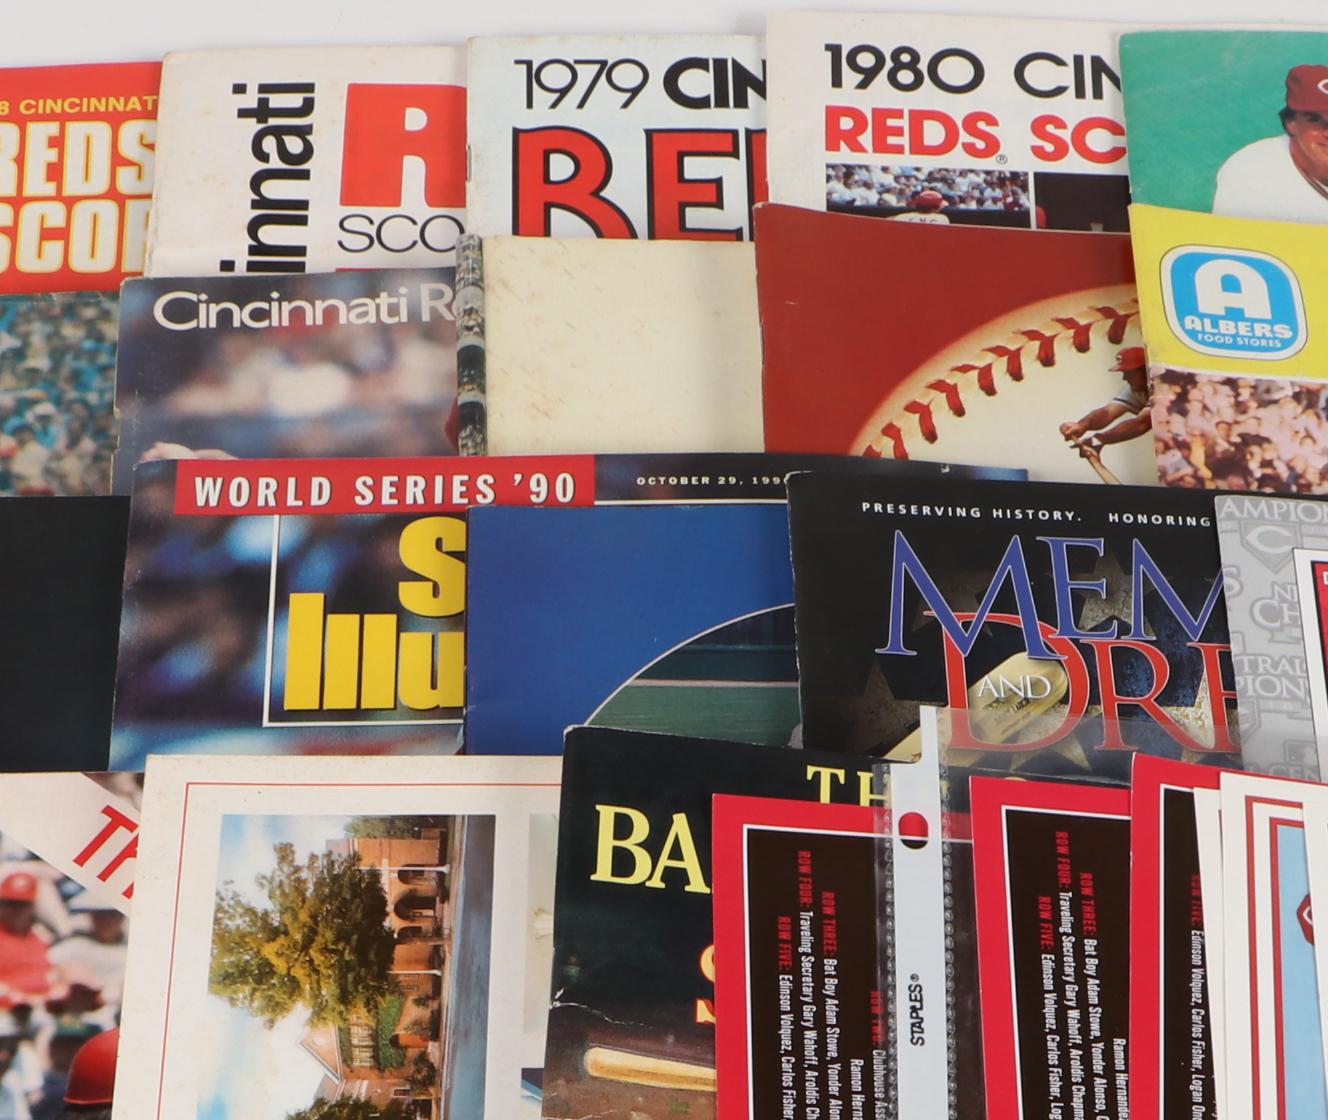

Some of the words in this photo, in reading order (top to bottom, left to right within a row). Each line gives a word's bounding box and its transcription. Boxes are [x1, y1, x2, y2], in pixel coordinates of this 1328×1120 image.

[514, 58, 649, 109] 1979
[663, 56, 767, 109] CIN
[825, 43, 985, 94] 1980
[825, 105, 1001, 159] REDS
[1030, 114, 1128, 164] SC
[1195, 259, 1272, 319] A
[153, 286, 408, 331] Cincinnati
[1184, 315, 1293, 339] ALBERS
[1197, 333, 1233, 345] FOOD
[1237, 337, 1282, 348] STORES
[195, 476, 332, 508] WORLD
[355, 473, 496, 505] SERIES
[514, 472, 574, 503] '90
[636, 477, 710, 486] OCTOBER
[717, 477, 744, 488] 29,
[862, 502, 982, 519] PRESERVING
[992, 508, 1083, 522] HISTORY.
[1108, 512, 1211, 528] HONORING
[978, 675, 1052, 699] AND
[779, 975, 793, 1011] Edinson
[778, 1014, 794, 1054] Volquez,
[781, 1056, 796, 1088] Carlos
